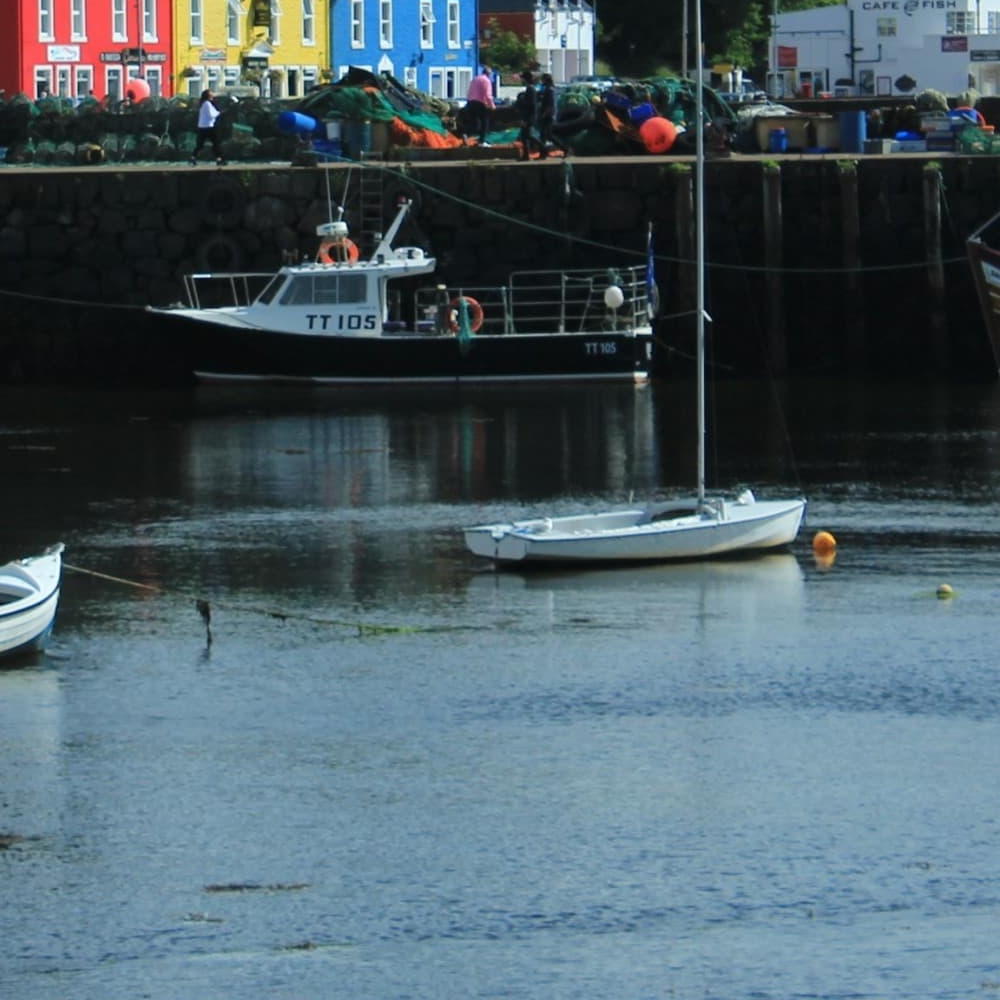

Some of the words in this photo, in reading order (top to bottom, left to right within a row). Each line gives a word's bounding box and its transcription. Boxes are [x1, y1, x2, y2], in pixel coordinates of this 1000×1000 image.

[862, 0, 900, 11] CAFE
[922, 0, 956, 9] FISH
[306, 314, 332, 330] TT
[338, 314, 377, 330] 105
[584, 342, 599, 354] TT
[600, 342, 617, 354] 105
